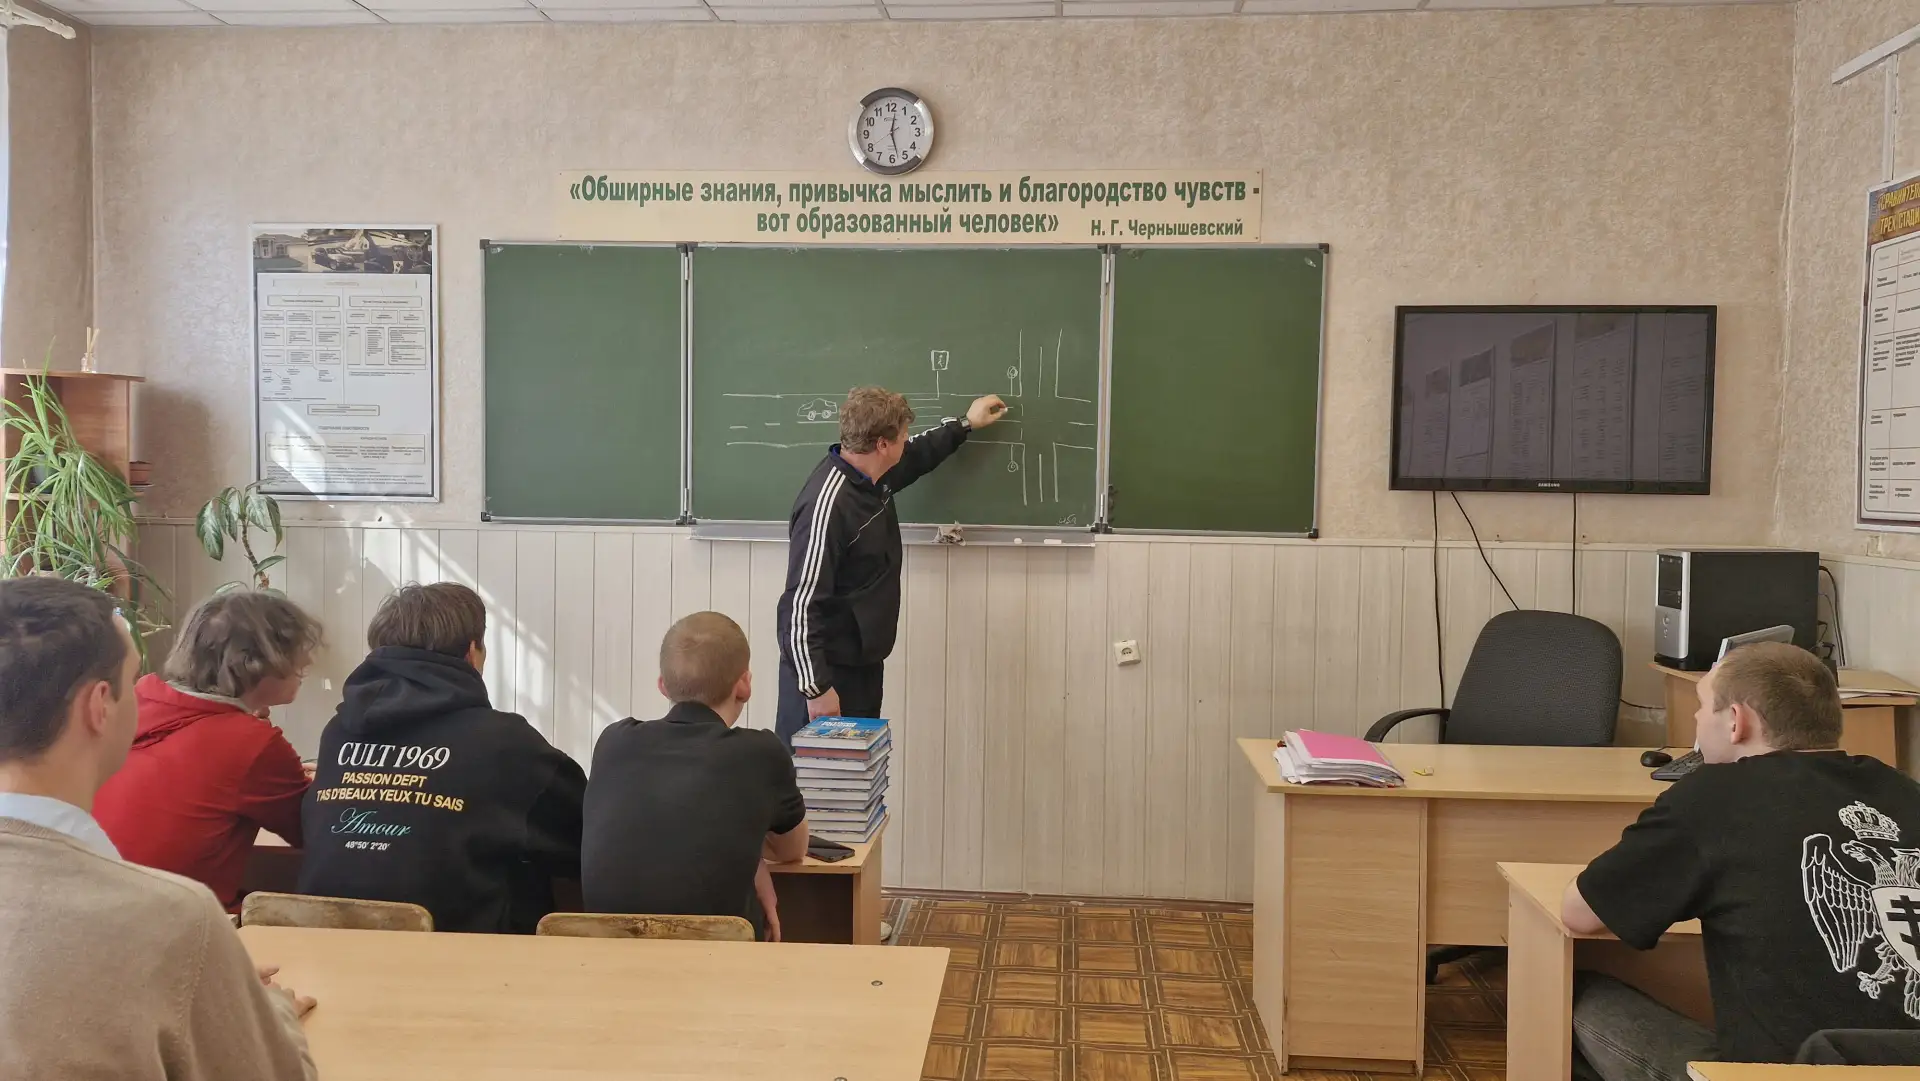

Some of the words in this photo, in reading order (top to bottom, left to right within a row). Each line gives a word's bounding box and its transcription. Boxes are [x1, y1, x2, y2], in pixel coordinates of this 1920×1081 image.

[874, 107, 883, 117] 11
[885, 102, 897, 113] 12
[901, 106, 907, 116] 1
[865, 117, 875, 127] 10
[910, 115, 917, 125] 2
[863, 129, 870, 139] 9
[914, 127, 921, 137] 3
[867, 143, 874, 152] 8
[909, 141, 916, 150] 4
[876, 151, 883, 161] 7
[888, 154, 896, 164] 6
[901, 150, 908, 160] 5
[570, 175, 694, 207] «Обширные
[700, 183, 782, 207] знания,
[788, 182, 892, 208] привычка
[900, 180, 992, 203] мыслить
[999, 182, 1012, 202] и
[1019, 176, 1167, 208] благородство
[1174, 181, 1246, 208] чувств
[757, 212, 790, 232] вот
[796, 206, 952, 238] образованный
[959, 213, 1059, 233] человек»
[1879, 214, 1897, 235] ТРЕХ
[1091, 219, 1106, 236] Н.
[1110, 220, 1123, 236] Г.
[1128, 218, 1243, 239] Чернышевский
[337, 742, 396, 767] CULT
[393, 745, 450, 770] 1969
[341, 772, 395, 785] PASSION
[392, 774, 427, 787] DEPT
[379, 790, 411, 803] YEUX
[414, 791, 432, 805] TU
[433, 794, 464, 811] SAIS
[331, 807, 412, 836] Amour
